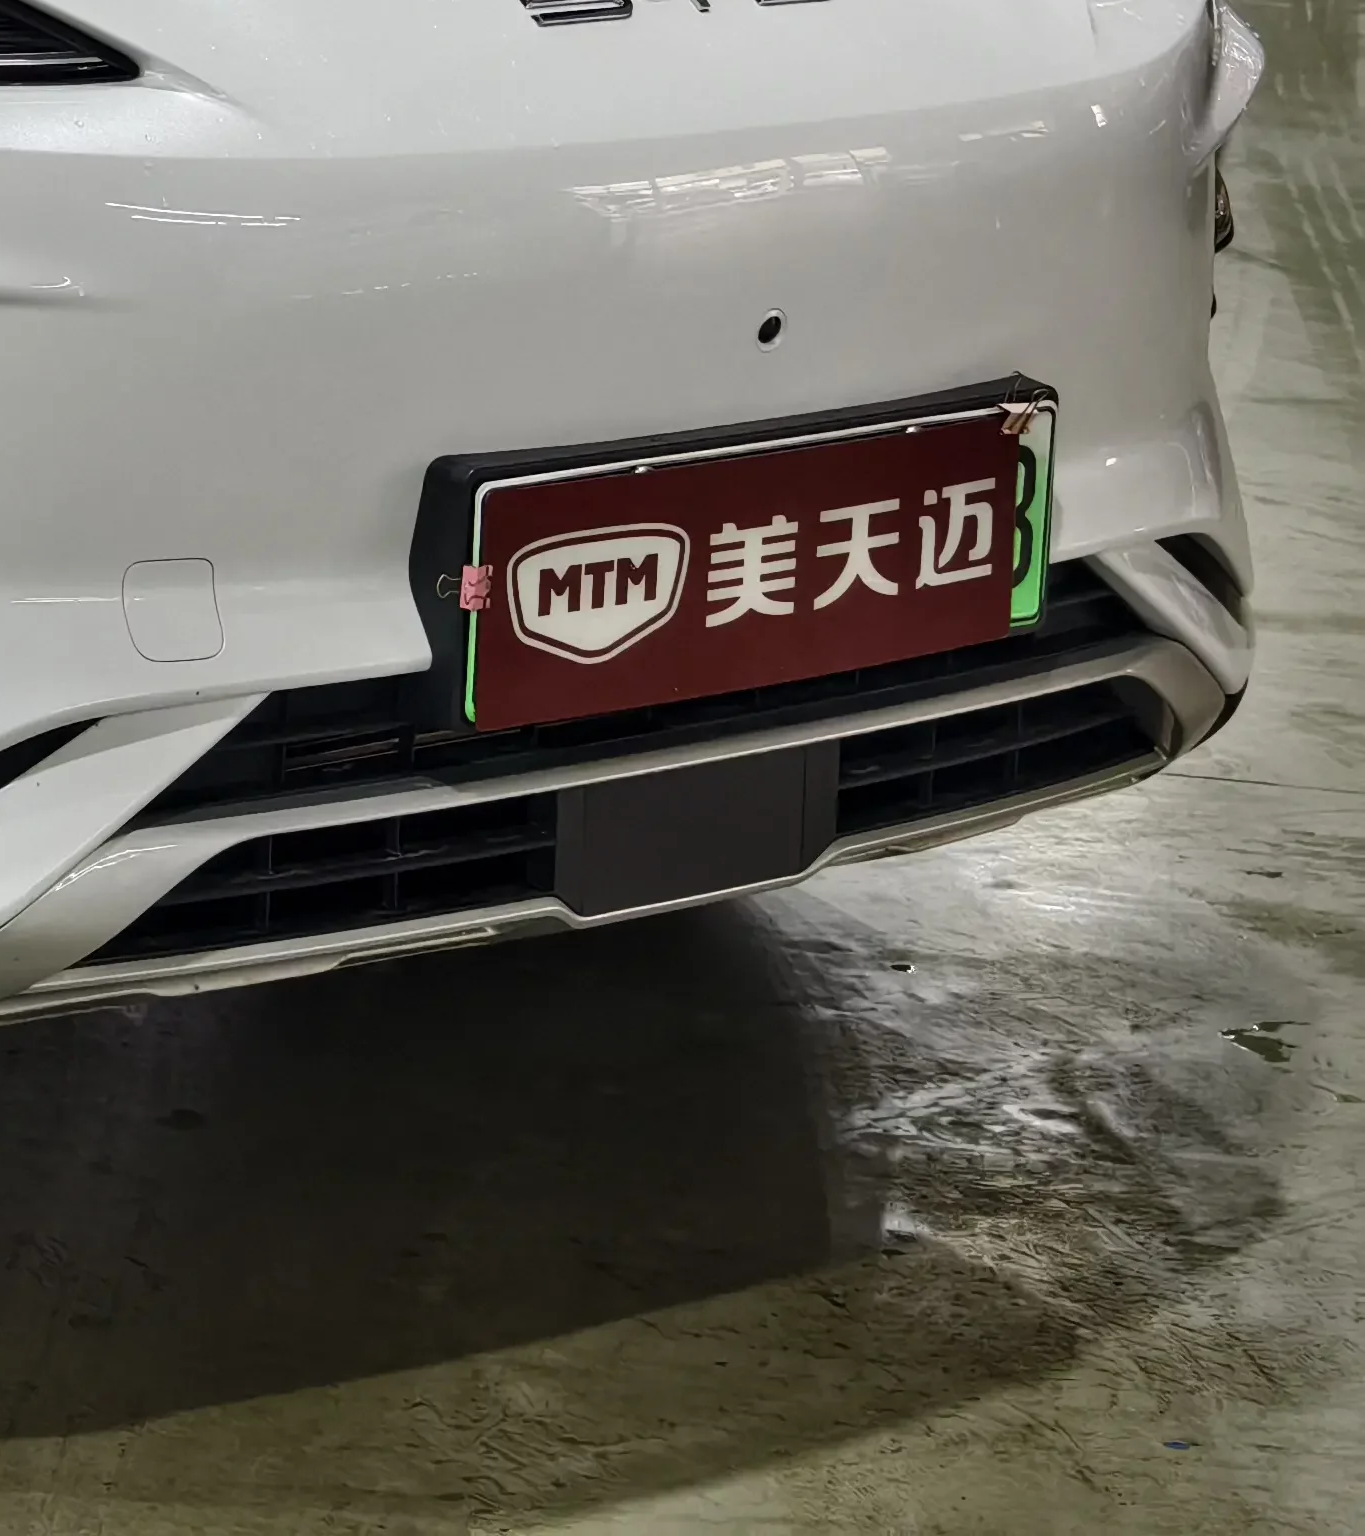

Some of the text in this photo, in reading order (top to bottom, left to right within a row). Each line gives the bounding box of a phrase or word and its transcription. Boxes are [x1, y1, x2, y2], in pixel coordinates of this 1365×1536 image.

[537, 552, 661, 617] MTM
[705, 477, 997, 628] 美天迈
